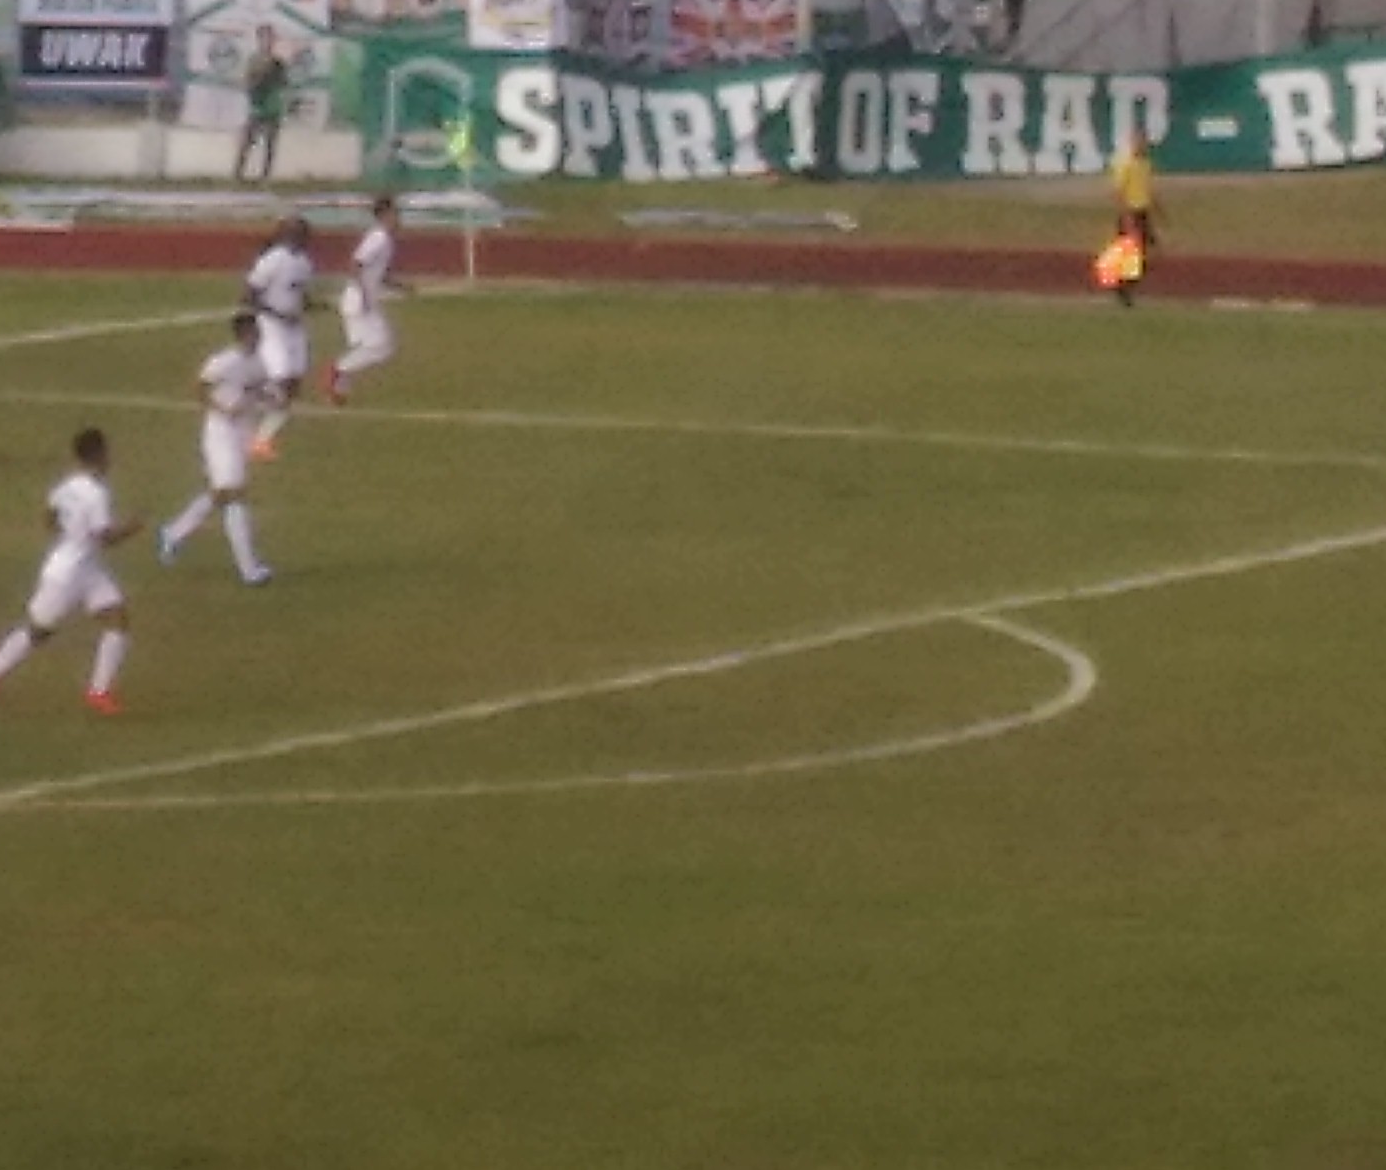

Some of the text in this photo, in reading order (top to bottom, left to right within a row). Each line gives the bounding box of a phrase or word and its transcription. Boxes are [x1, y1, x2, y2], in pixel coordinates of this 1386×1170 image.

[40, 30, 150, 69] UWAK
[496, 66, 825, 182] SPIRIT
[837, 71, 941, 174] OF
